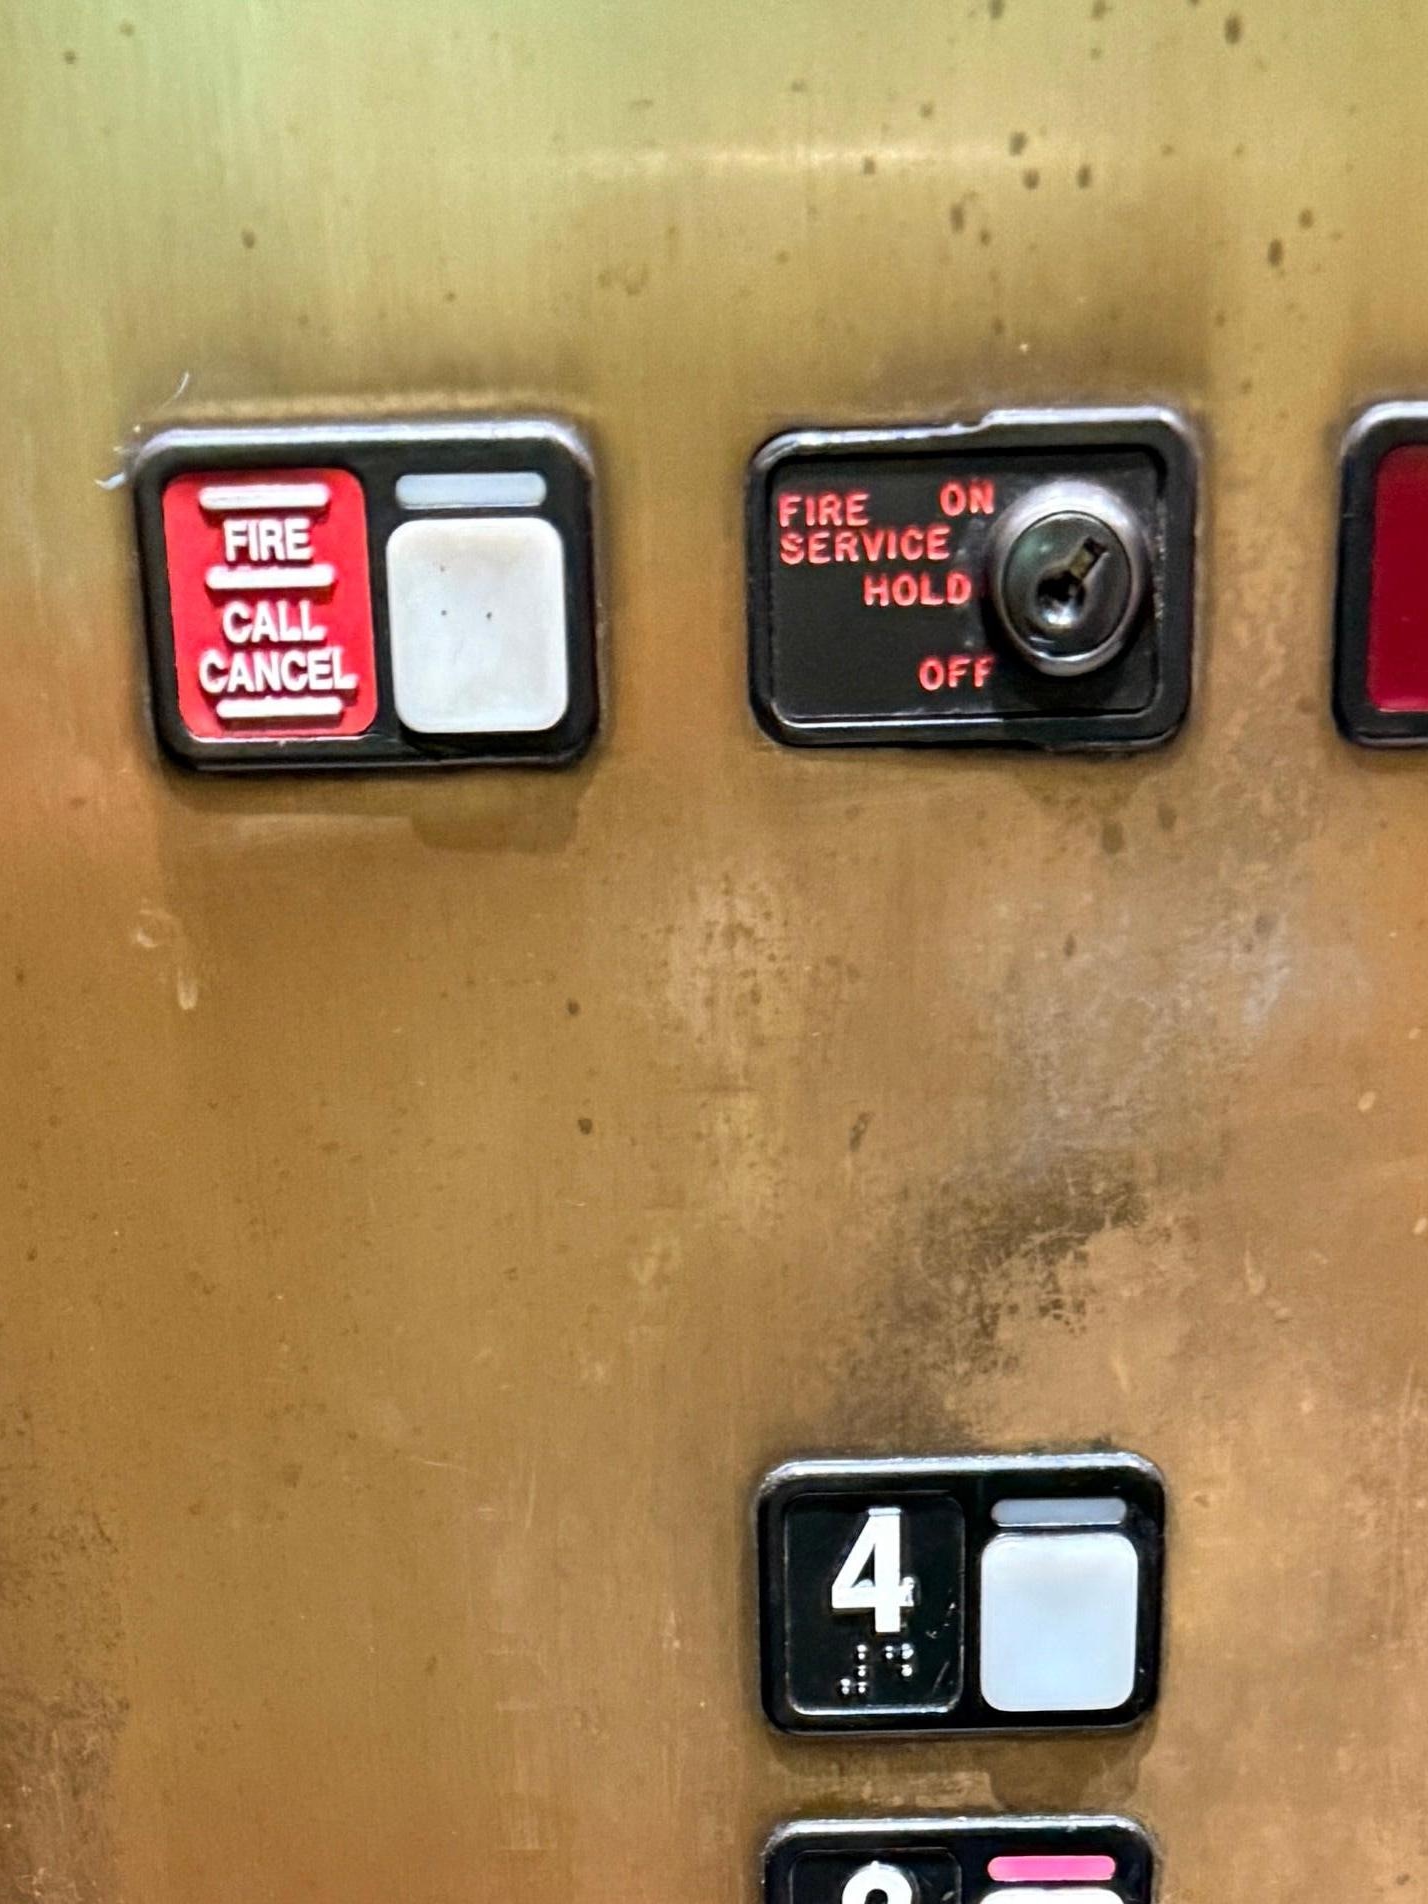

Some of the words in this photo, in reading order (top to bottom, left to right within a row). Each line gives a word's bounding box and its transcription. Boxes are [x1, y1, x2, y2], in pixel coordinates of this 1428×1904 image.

[778, 491, 869, 527] FIRE
[939, 479, 995, 517] ON
[223, 517, 314, 561] FIRE
[779, 525, 951, 565] SERVICE
[863, 571, 971, 607] HOLD
[223, 599, 328, 643] CALL
[198, 645, 358, 693] CANCEL
[918, 654, 995, 691] OFF
[831, 1507, 915, 1633] 4
